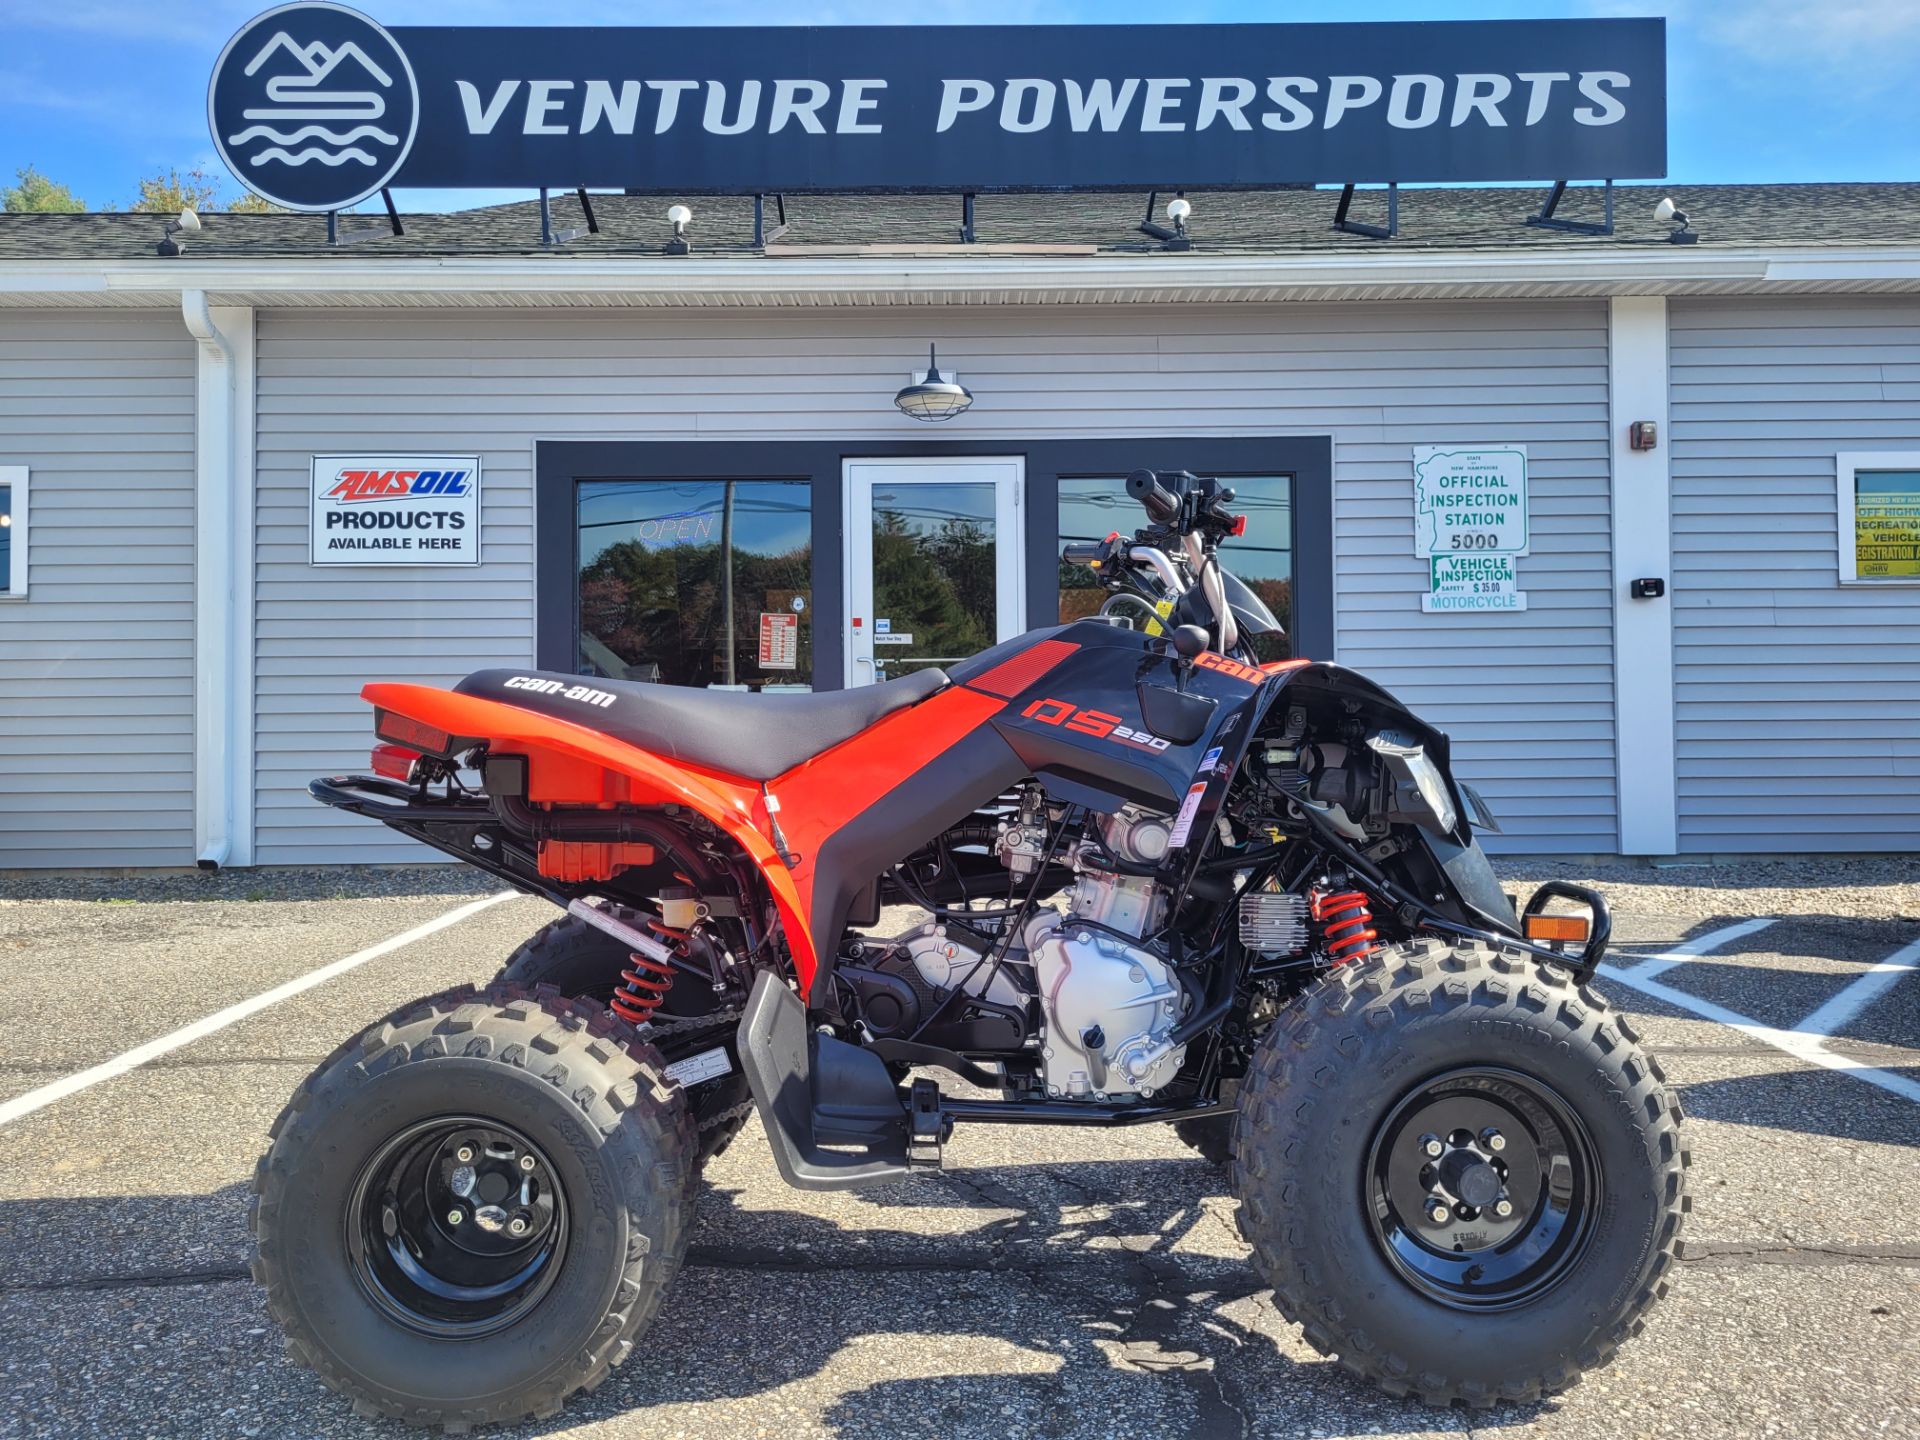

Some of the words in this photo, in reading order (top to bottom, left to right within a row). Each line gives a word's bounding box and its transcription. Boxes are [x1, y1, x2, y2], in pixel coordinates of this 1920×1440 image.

[455, 79, 888, 136] VENTURE
[936, 71, 1631, 134] POWERSPORTS
[327, 470, 468, 501] AMSOIL
[1439, 475, 1509, 488] OFFICIAL
[1430, 493, 1519, 508] INSPECTION
[1445, 512, 1505, 526] STATION
[1858, 507, 1881, 517] OFF
[326, 511, 466, 530] PRODUCTS
[1855, 520, 1920, 530] RECREATIO
[639, 517, 714, 540] OPEN
[327, 537, 412, 550] AVAILABLE
[418, 537, 462, 550] HERE
[1451, 533, 1499, 549] 5000
[1448, 558, 1507, 570] VEHICLE
[1441, 570, 1513, 582] INSPECTION
[1431, 594, 1517, 609] MOTORCYCLE
[1194, 652, 1265, 686] can
[503, 676, 617, 708] can-am
[1020, 698, 1123, 738] DS
[1112, 725, 1172, 751] 250
